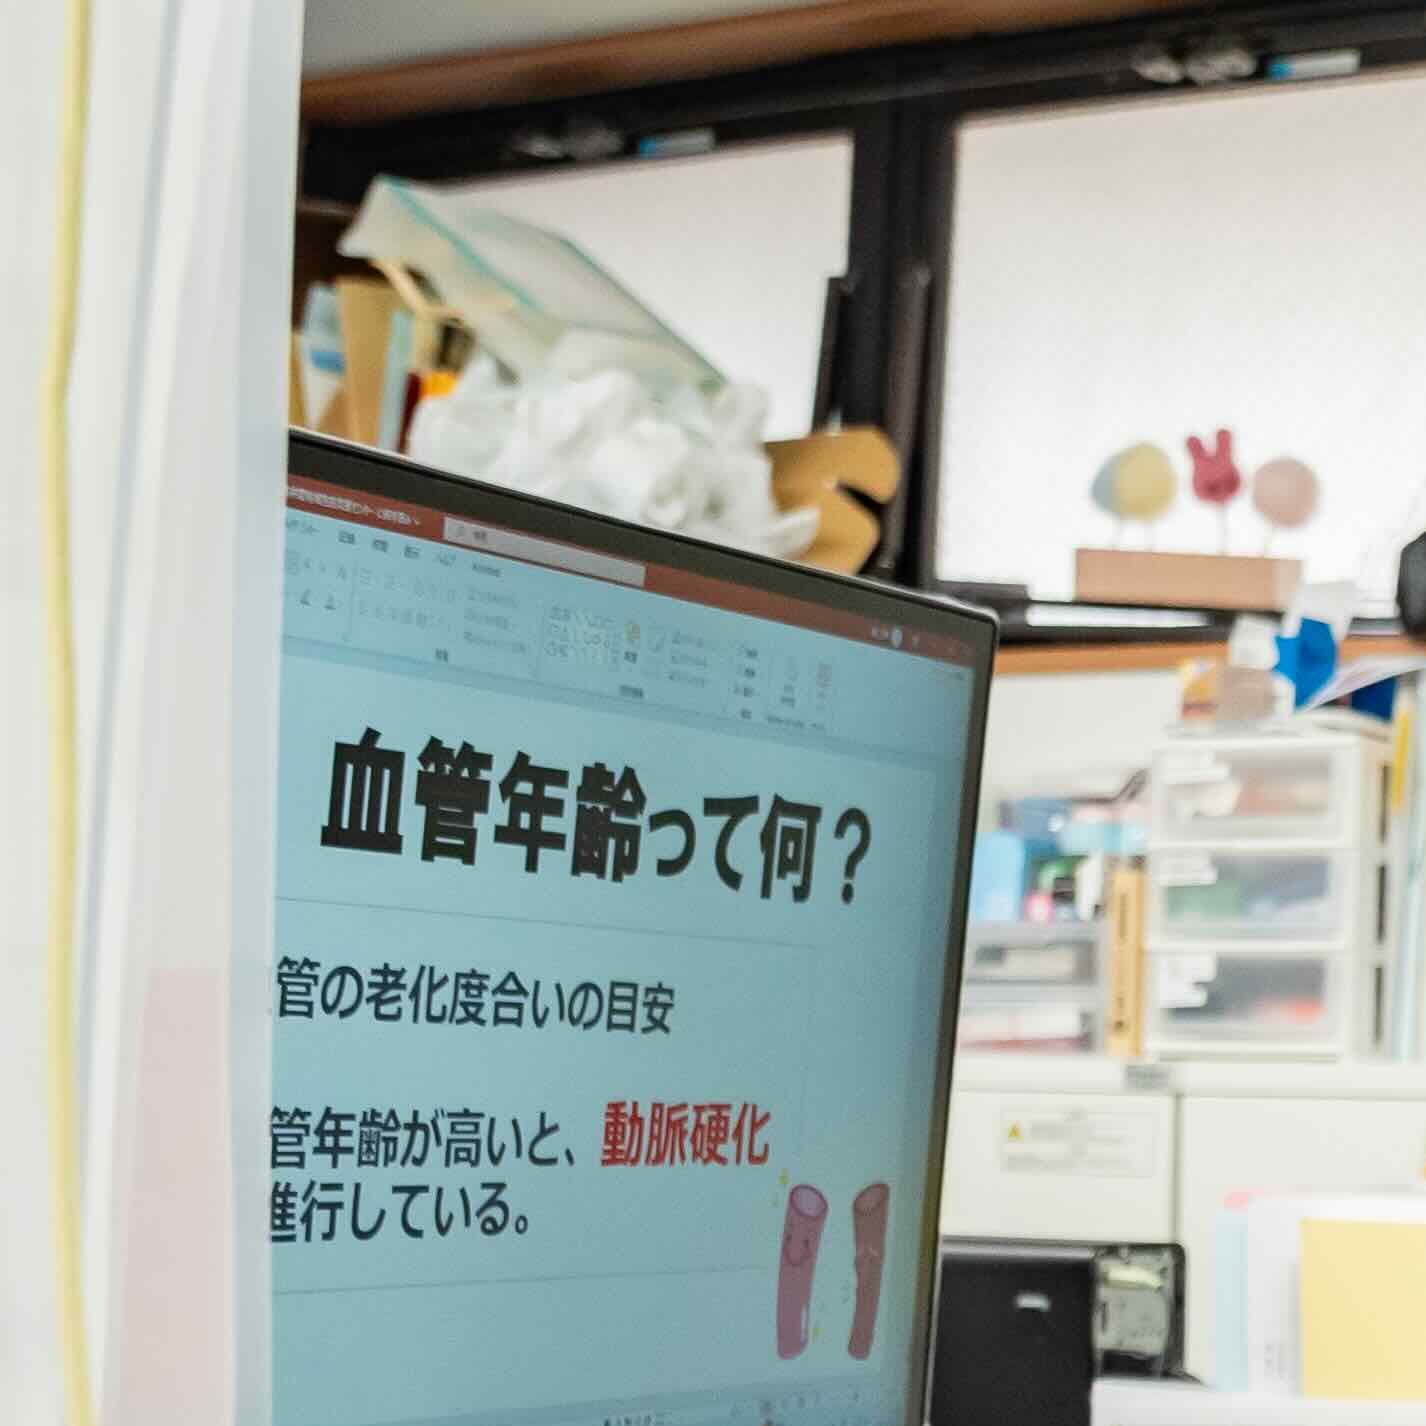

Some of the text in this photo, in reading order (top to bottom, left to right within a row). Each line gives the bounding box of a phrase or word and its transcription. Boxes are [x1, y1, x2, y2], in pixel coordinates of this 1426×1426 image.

[320, 726, 874, 906] 血管年齢って何？
[275, 955, 676, 1037] 管の老化度合いの目安
